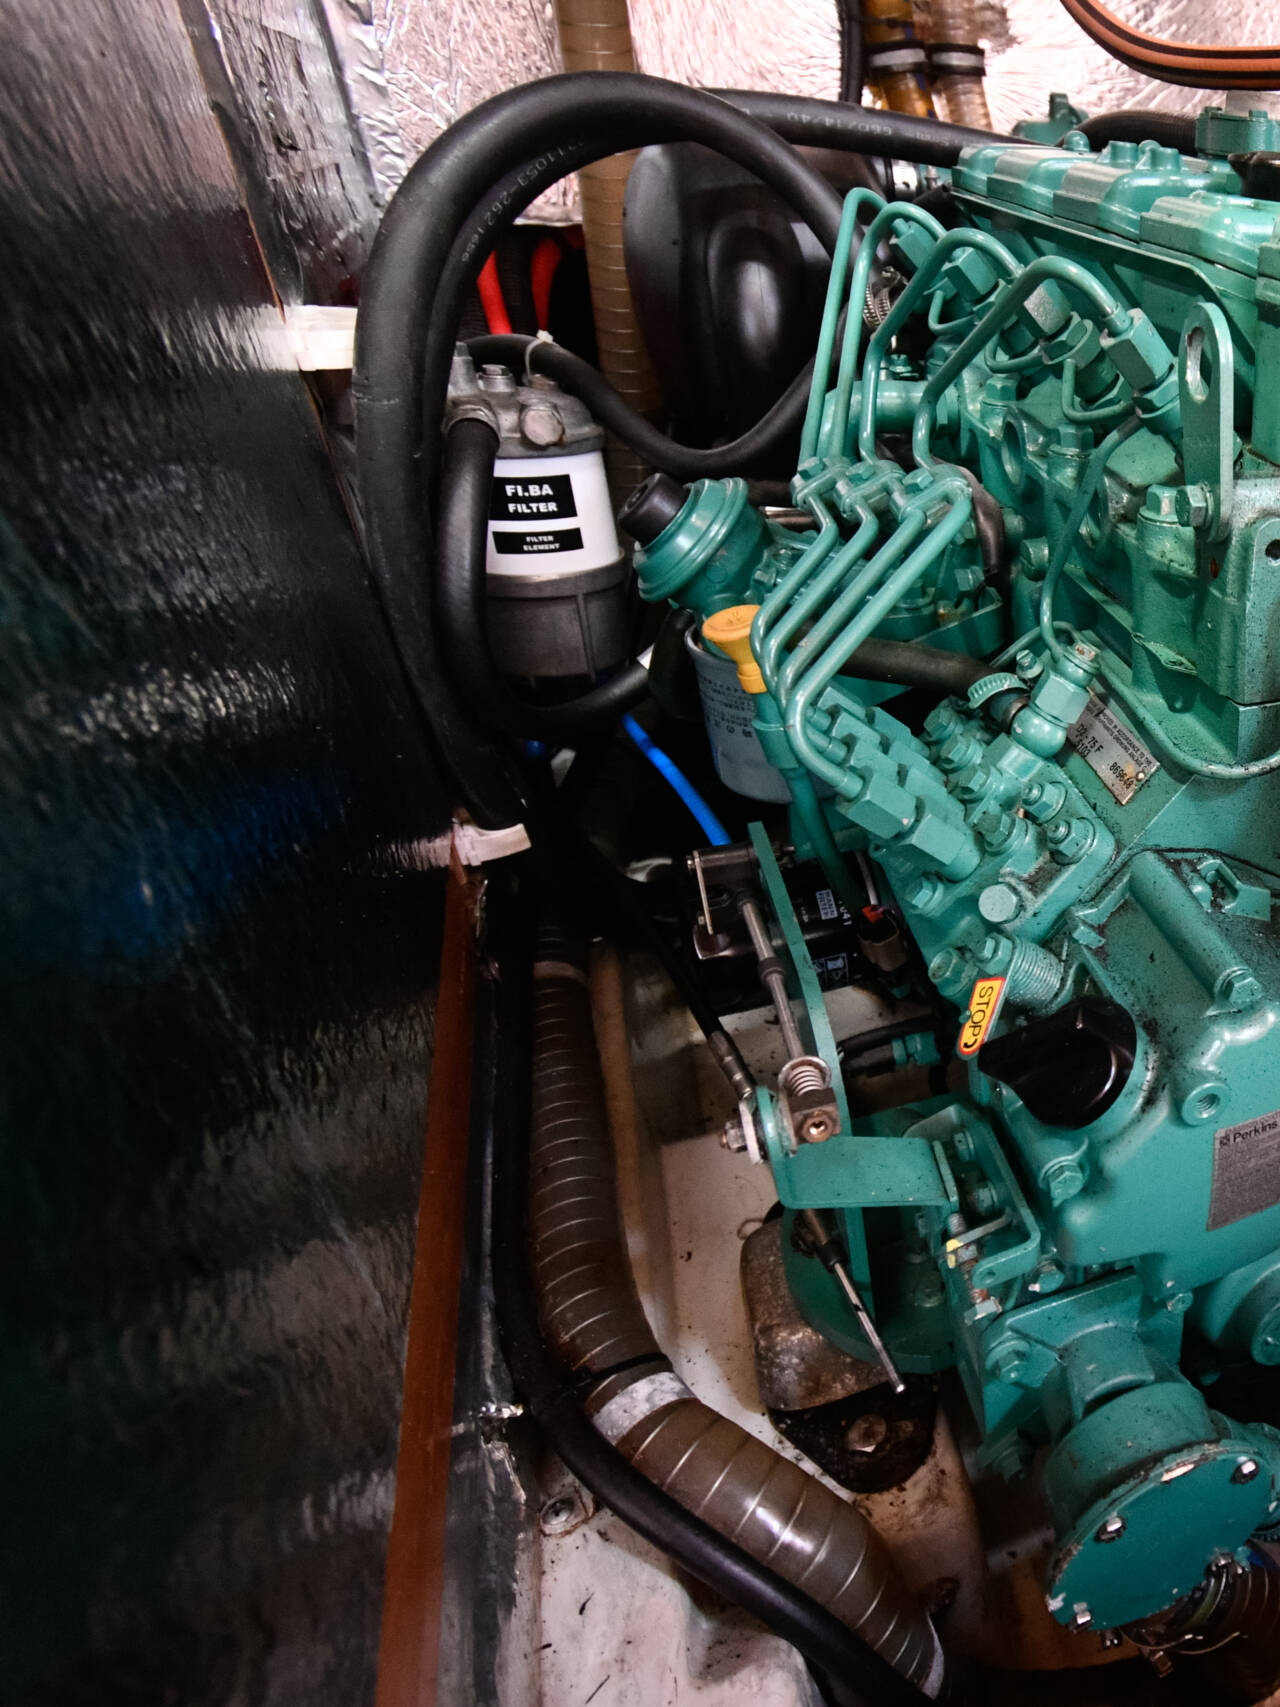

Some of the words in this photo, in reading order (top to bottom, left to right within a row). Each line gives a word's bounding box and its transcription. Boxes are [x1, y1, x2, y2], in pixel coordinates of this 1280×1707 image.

[505, 484, 554, 497] FI.BA
[507, 502, 558, 513] FILTER
[526, 535, 554, 543] FILTER
[523, 543, 560, 551] ELEMENT
[969, 985, 994, 1037] STOP
[1233, 1119, 1278, 1143] Perkins
